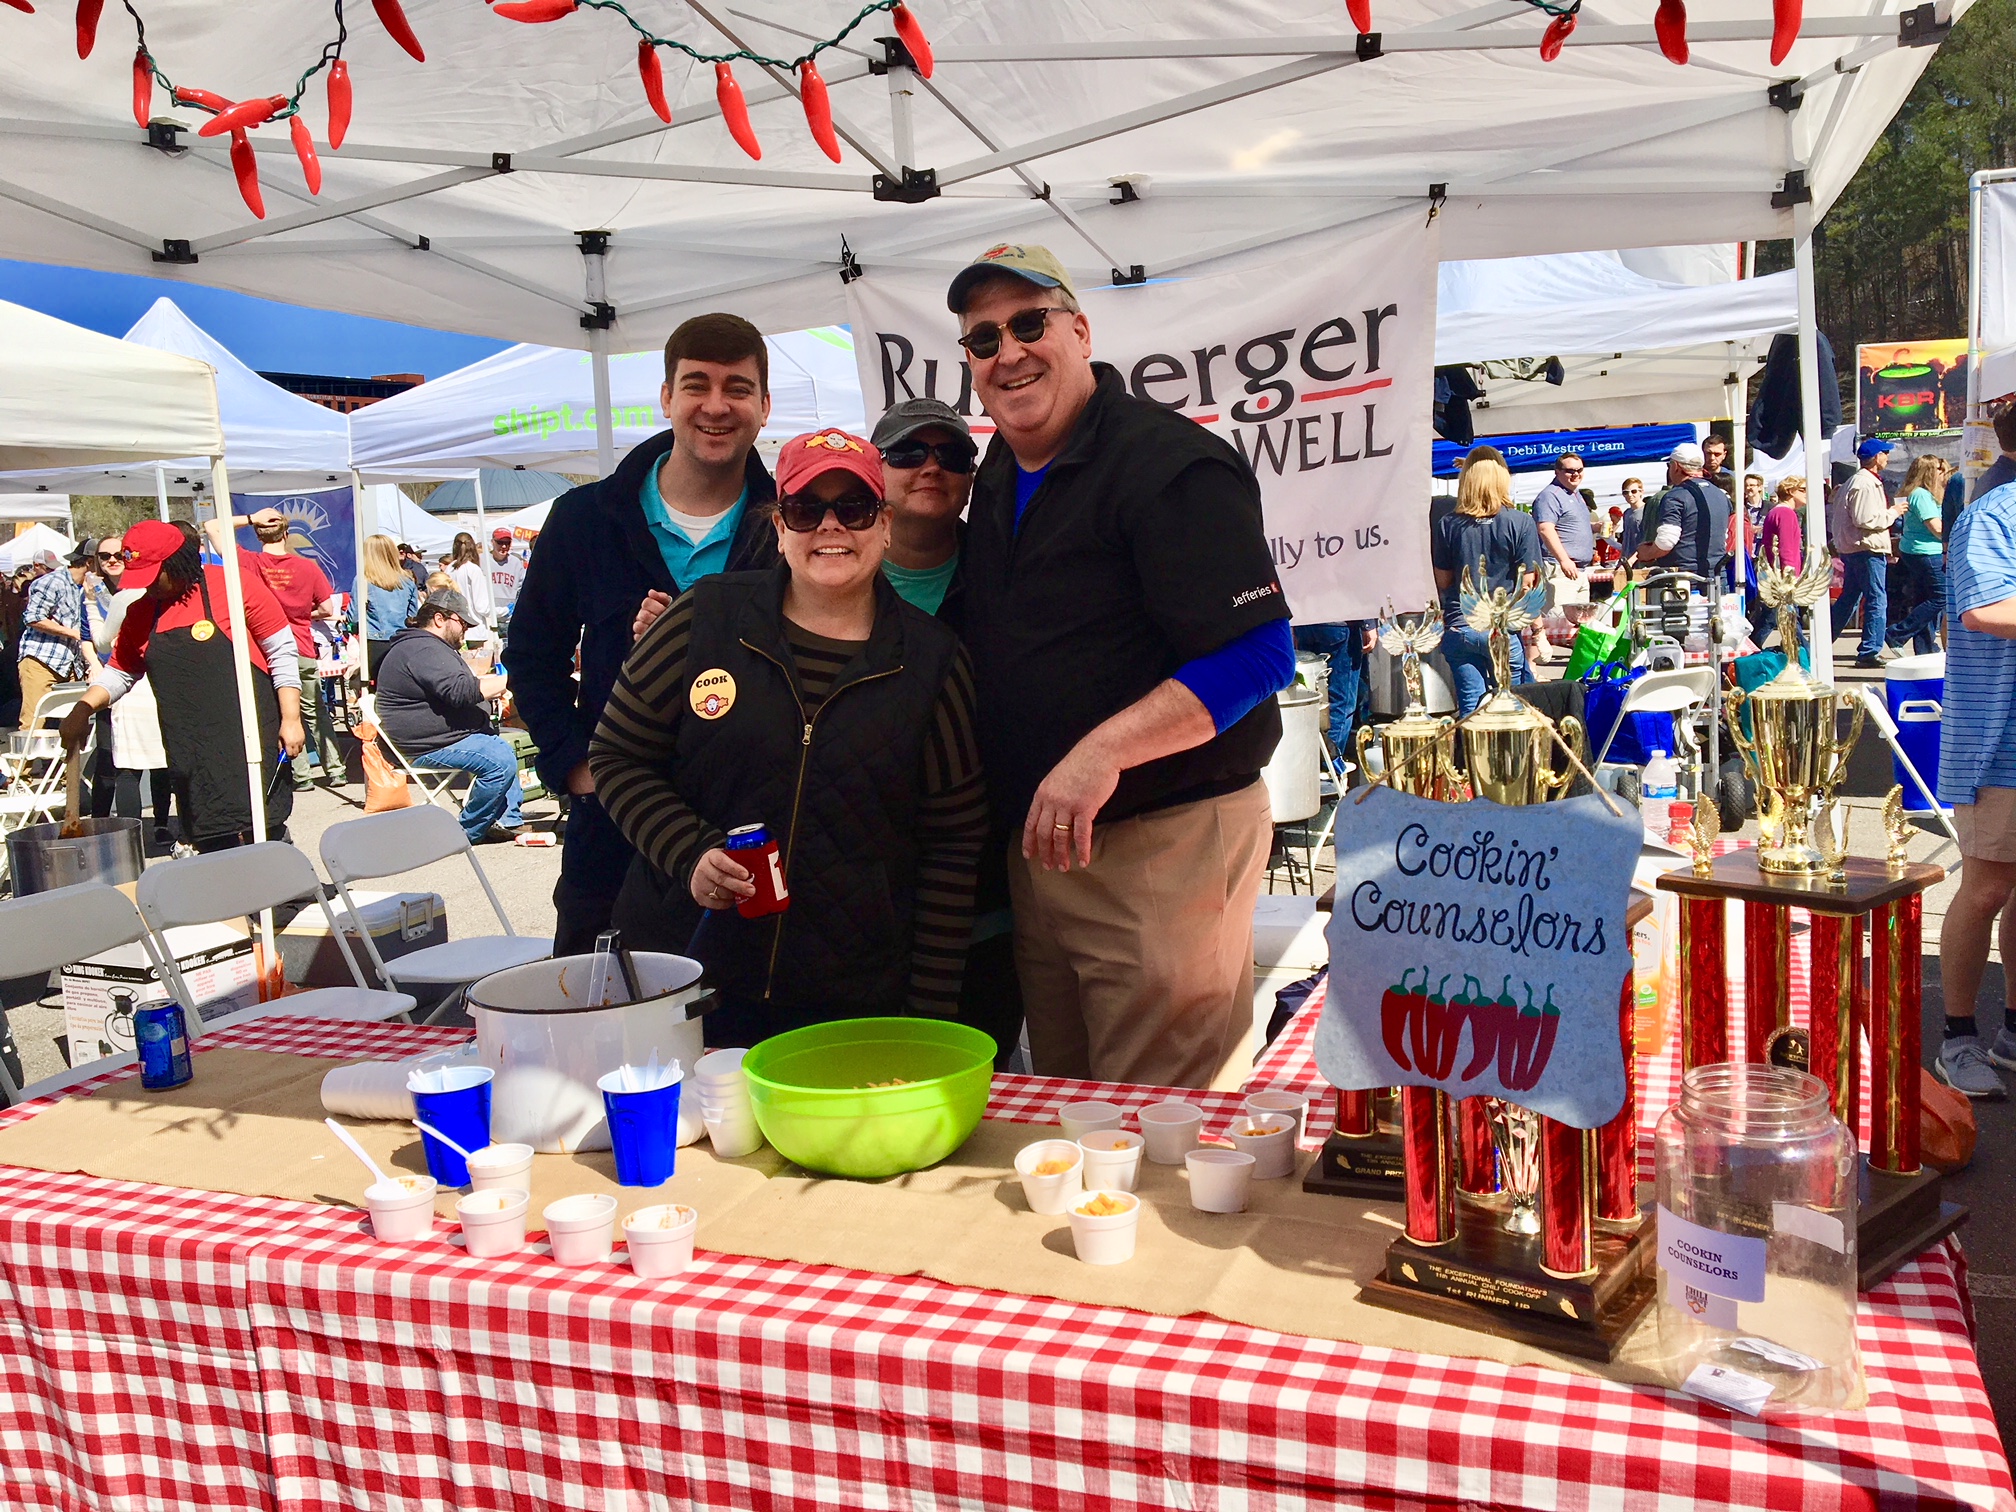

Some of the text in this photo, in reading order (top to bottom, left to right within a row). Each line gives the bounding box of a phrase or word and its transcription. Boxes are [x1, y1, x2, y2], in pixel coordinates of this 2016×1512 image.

[875, 302, 1398, 422] Ruerger
[1877, 390, 1935, 409] KBR
[1230, 403, 1395, 477] WELL
[1508, 444, 1537, 457] Debi
[1541, 441, 1585, 454] Mestre
[1589, 440, 1625, 452] Team
[1270, 524, 1389, 569] lly to us.
[491, 571, 515, 587] ATES
[1232, 586, 1272, 608] Jefferies
[695, 675, 728, 688] COOK
[1395, 822, 1559, 891] Cookin'
[1350, 879, 1608, 957] Counselors
[1355, 1167, 1382, 1176] GRAND
[1667, 1246, 1739, 1280] COUNSELORS
[1677, 1239, 1722, 1263] COOKIN
[1428, 1264, 1548, 1297] THE EXCEPTIONAL FOUNDATION'S
[1450, 1275, 1479, 1287] ANNUAL
[1481, 1282, 1500, 1291] CHILI
[1502, 1287, 1541, 1300] COOK-OFF
[1685, 1284, 1708, 1301] CHILI
[1466, 1290, 1511, 1306] RUNNER
